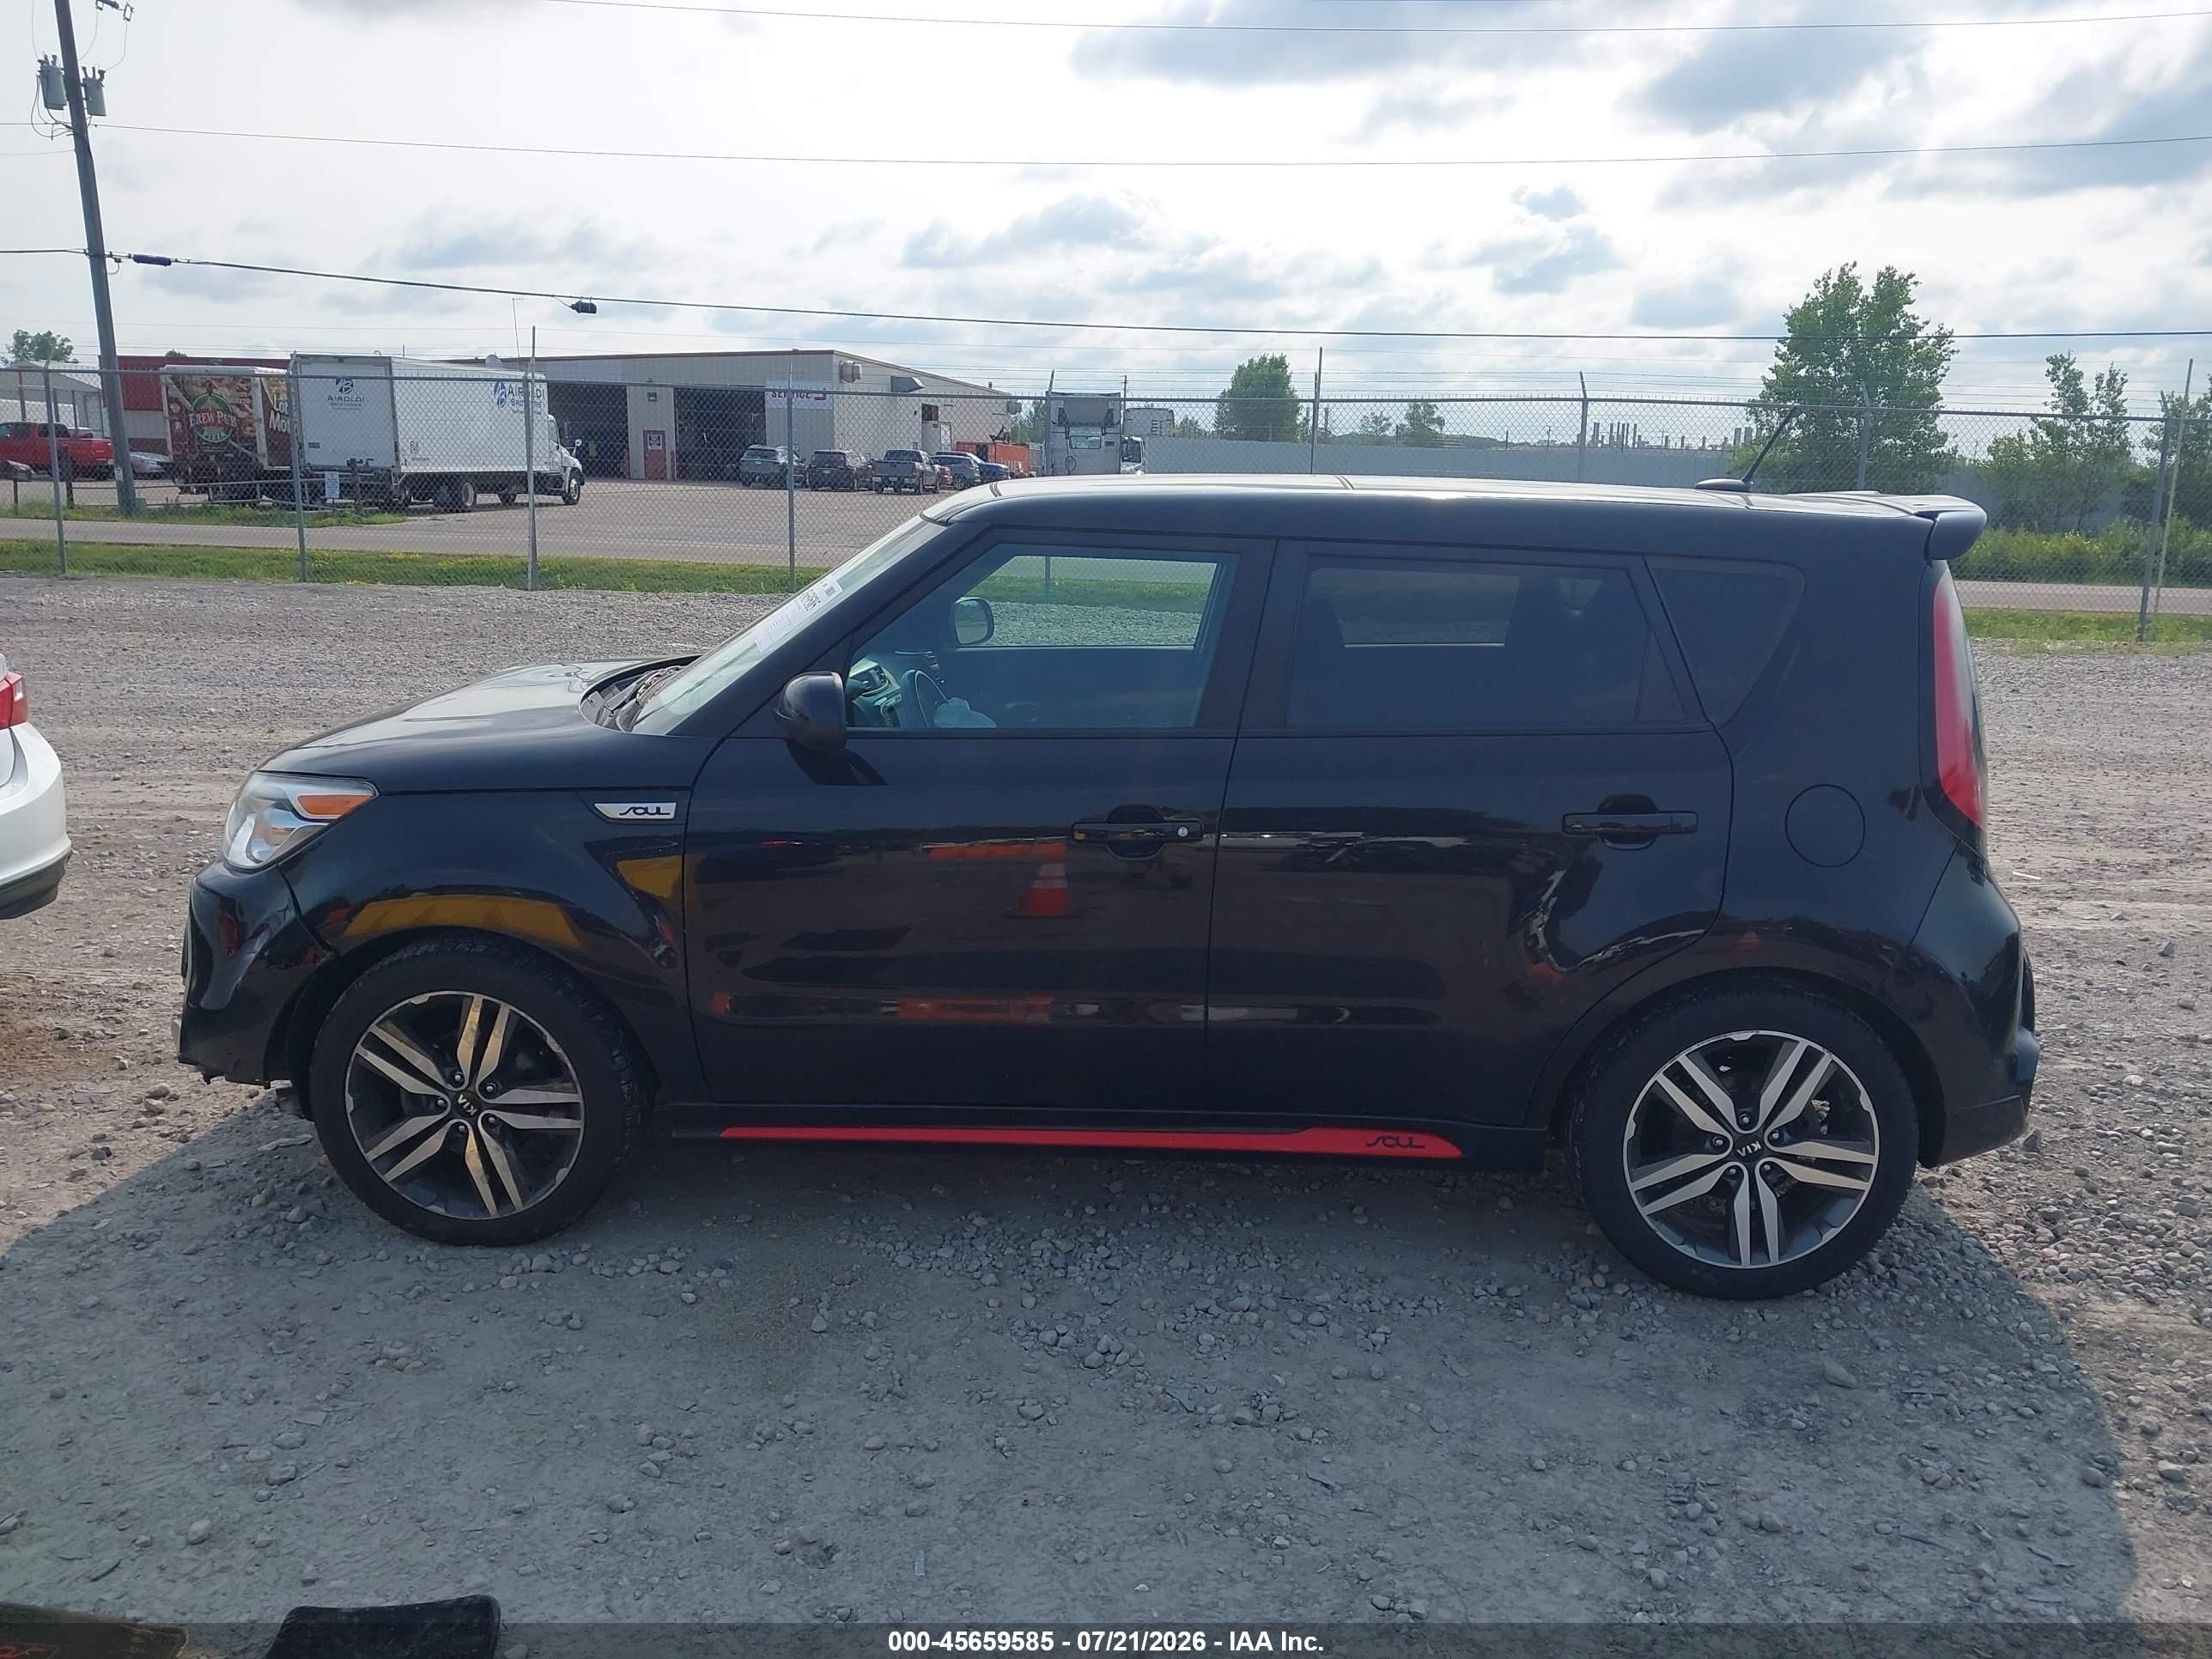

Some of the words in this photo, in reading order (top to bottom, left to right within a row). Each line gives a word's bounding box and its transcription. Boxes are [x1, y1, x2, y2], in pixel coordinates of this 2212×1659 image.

[508, 385, 544, 399] AIRDI
[772, 390, 811, 399] SERICE
[216, 410, 237, 428] PUB
[618, 805, 672, 816] SOUL
[457, 1094, 477, 1115] KIA
[1365, 1135, 1425, 1149] SOUL
[1736, 1140, 1762, 1157] KIA
